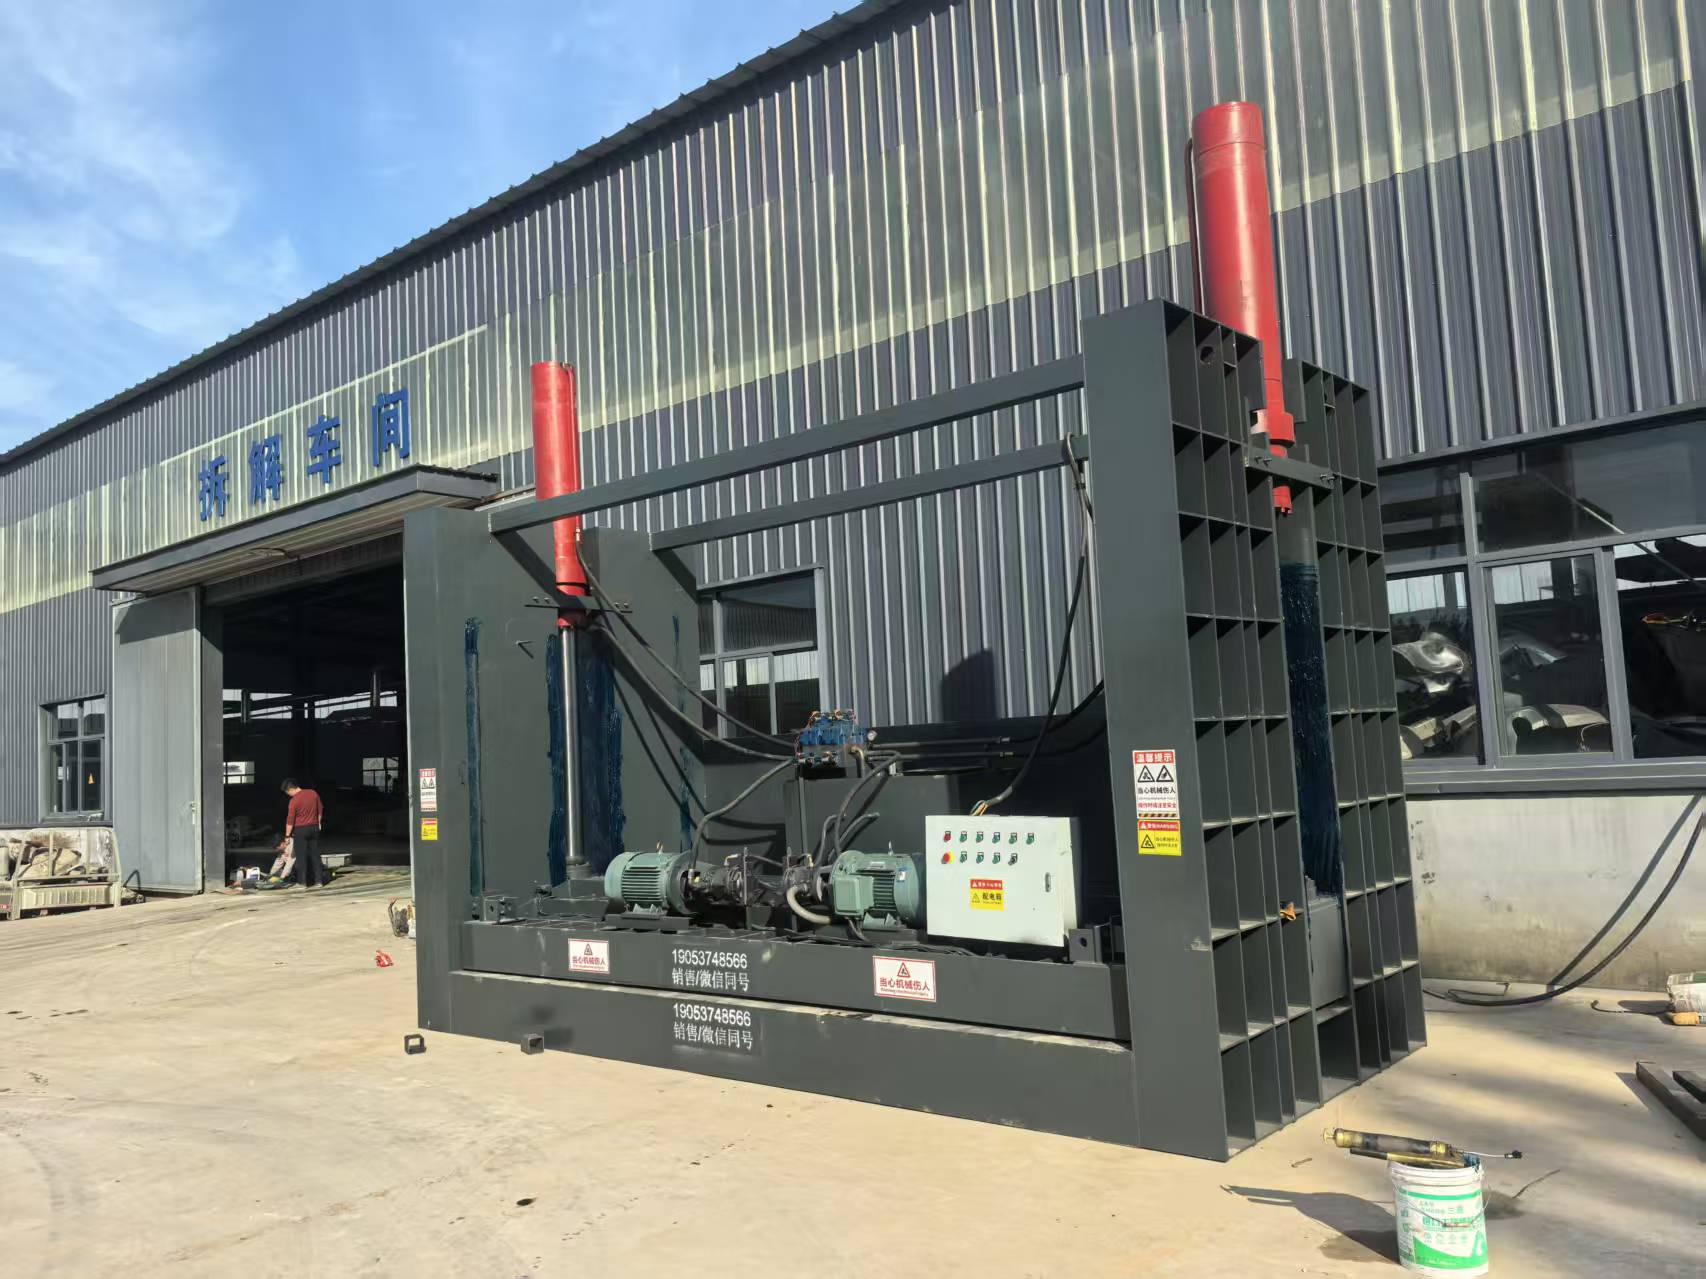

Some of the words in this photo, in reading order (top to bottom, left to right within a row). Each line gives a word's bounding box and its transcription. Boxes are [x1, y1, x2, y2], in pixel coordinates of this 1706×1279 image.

[198, 387, 410, 521] 拆解车间
[1137, 786, 1176, 795] 当心机械伤人
[672, 948, 748, 969] 19053748566
[672, 967, 749, 992] 销售/微信同号
[879, 976, 930, 992] 当心机械伤人
[673, 1002, 751, 1027] 19053748566
[673, 1021, 753, 1050] 销售/微信同号
